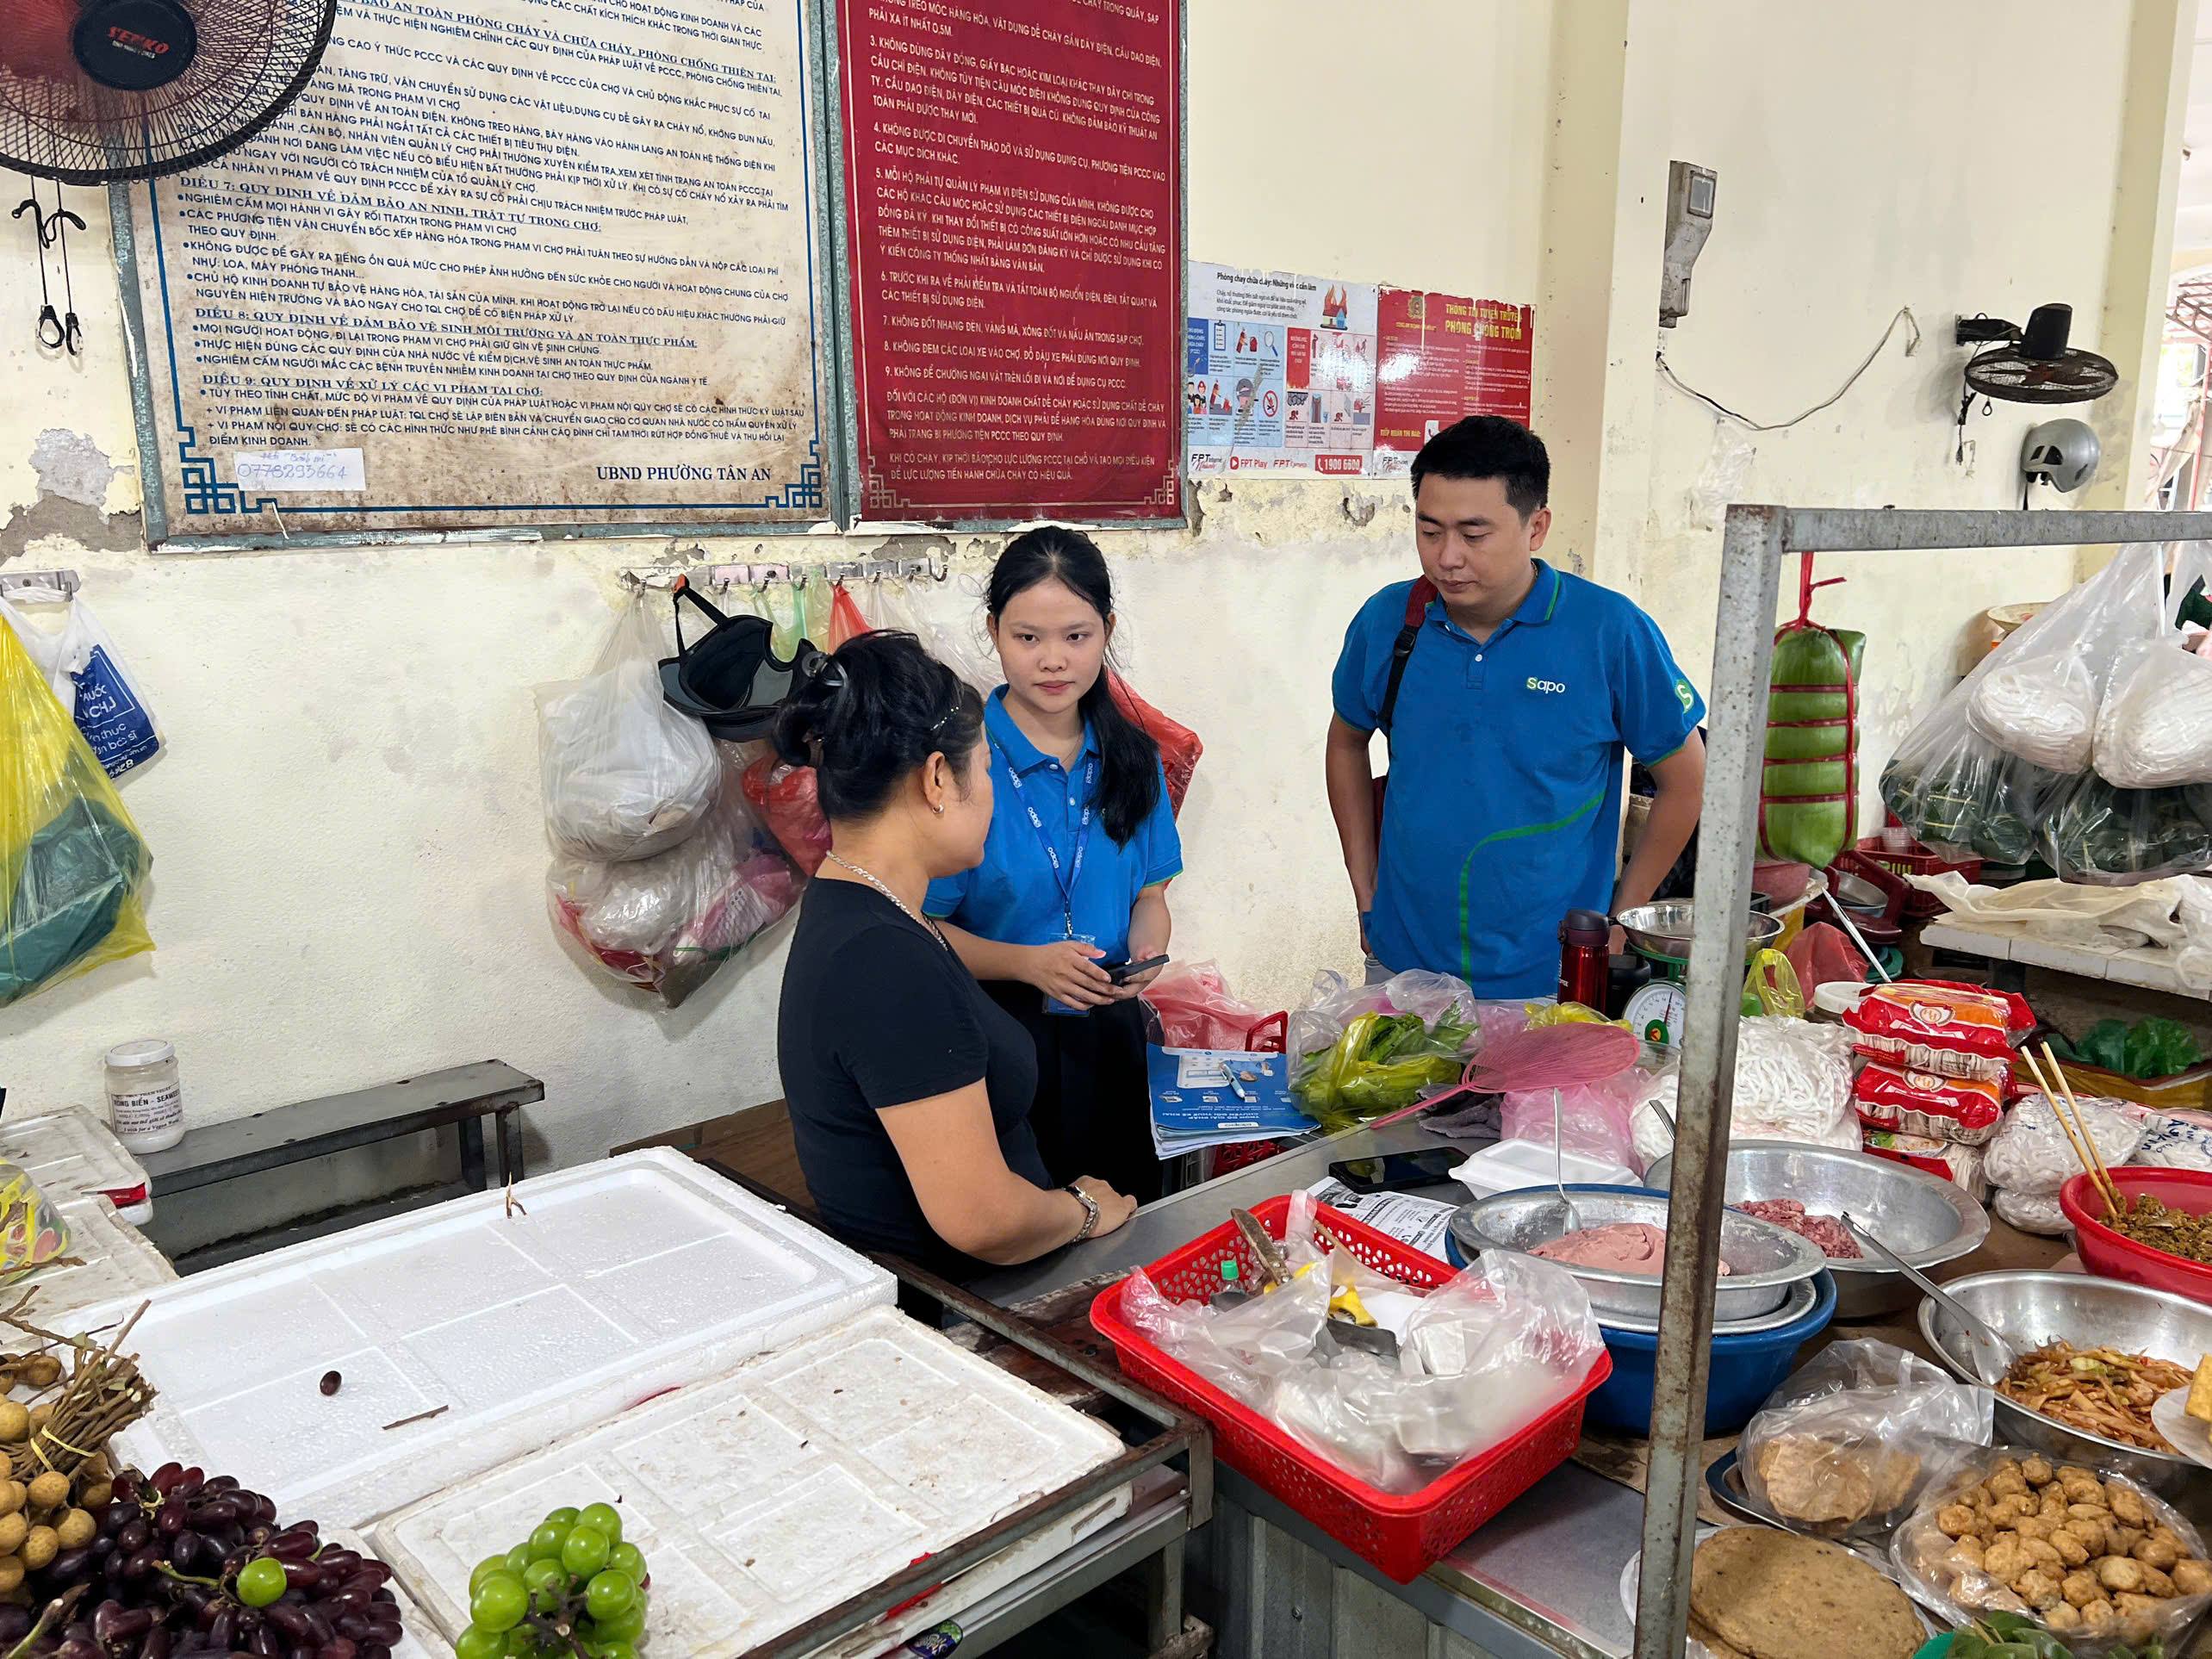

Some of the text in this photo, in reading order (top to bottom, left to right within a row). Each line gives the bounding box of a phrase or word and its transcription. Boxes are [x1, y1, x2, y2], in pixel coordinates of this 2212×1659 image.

[394, 2, 413, 14] AN
[239, 183, 270, 196] QUY
[408, 202, 427, 213] AN
[528, 215, 570, 228] TRONG
[323, 207, 334, 216] VI
[383, 214, 418, 225] TTATXH
[419, 217, 452, 229] TRONG
[484, 224, 494, 233] VI
[188, 224, 218, 236] THEO
[220, 227, 245, 239] QUY
[253, 311, 284, 323] QUY
[441, 324, 472, 334] SINH
[577, 332, 593, 342] AN
[366, 332, 401, 344] TRONG
[432, 337, 444, 346] VI
[545, 344, 566, 352] SINH
[240, 436, 267, 445] KINH
[270, 437, 311, 446] DOANH.
[597, 464, 771, 481] UBND PHƯỜNG TÂN AN
